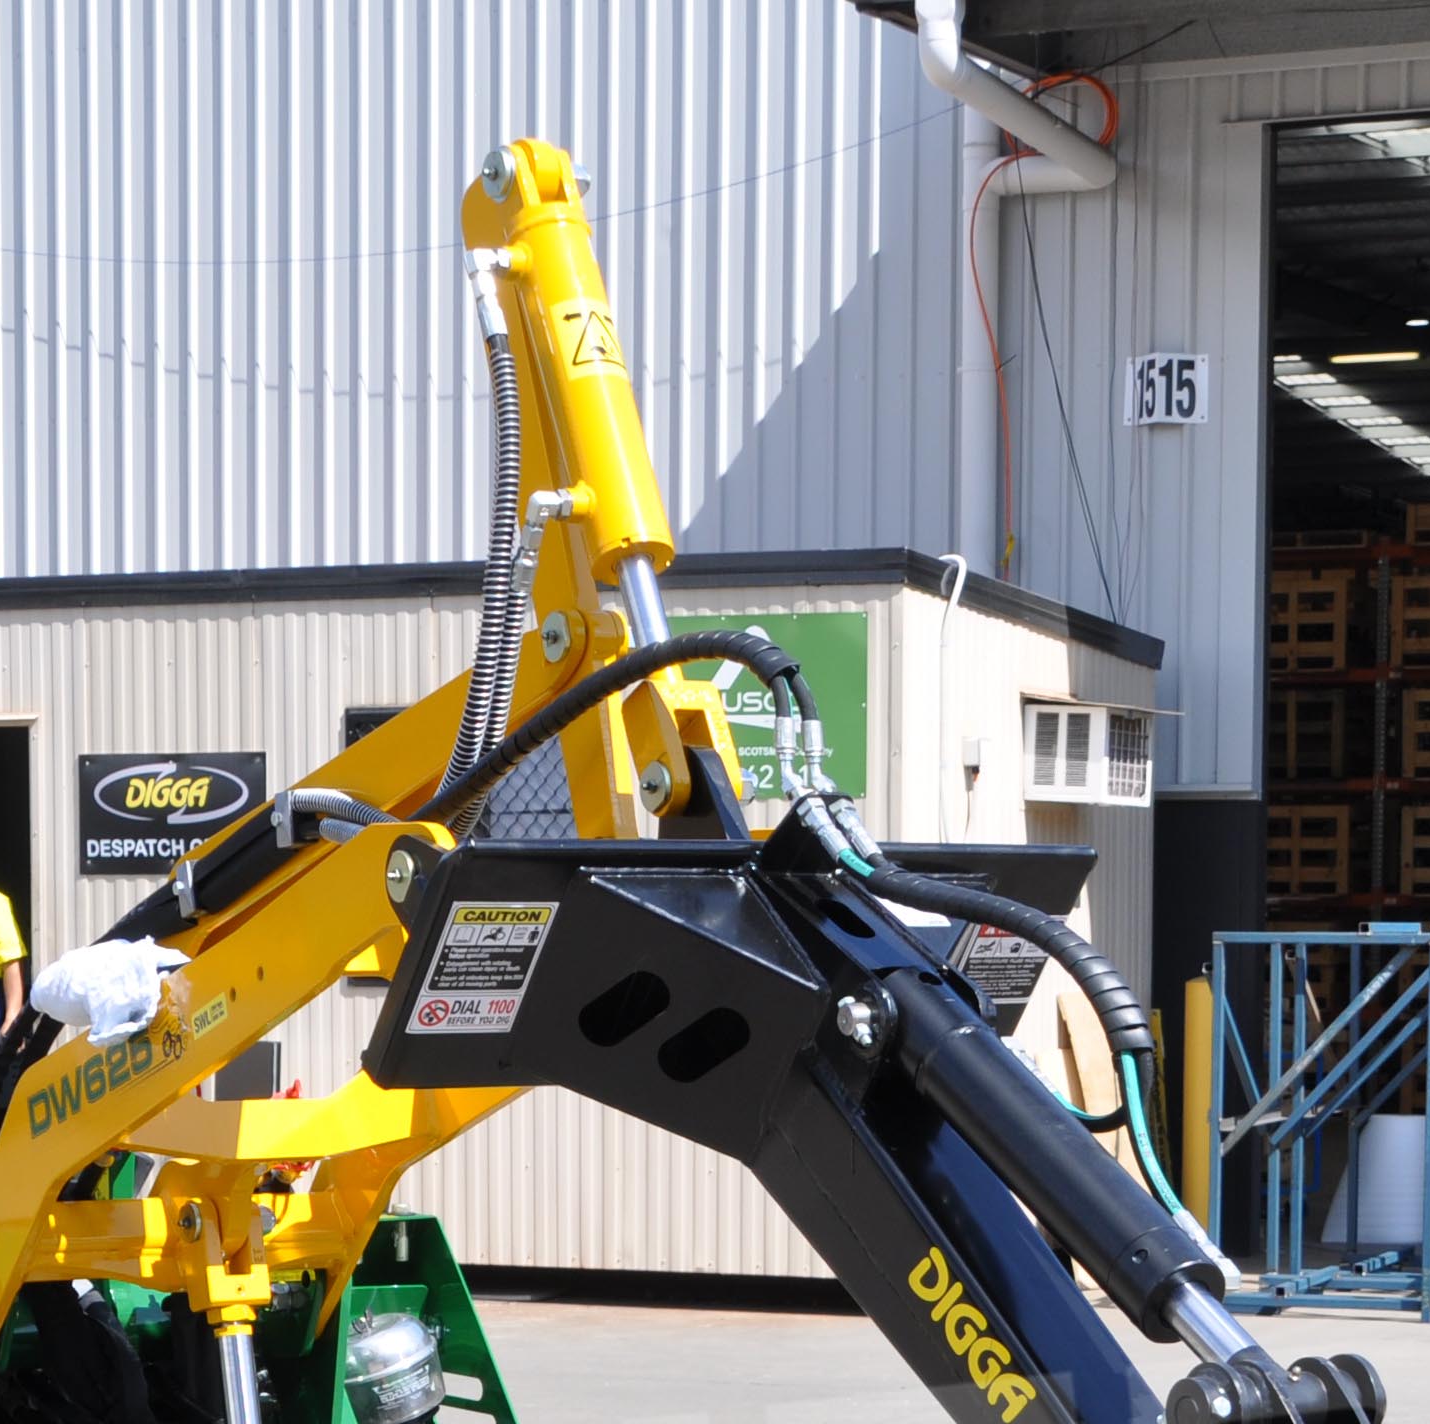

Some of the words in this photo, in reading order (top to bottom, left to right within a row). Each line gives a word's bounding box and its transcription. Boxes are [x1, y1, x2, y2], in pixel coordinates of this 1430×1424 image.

[1137, 358, 1156, 419] 15
[1158, 358, 1196, 418] 15
[125, 777, 210, 809] DIGGA
[86, 838, 184, 858] DESPATCH
[463, 911, 542, 922] CAUTION
[450, 1000, 481, 1015] DIAL
[486, 999, 516, 1014] 1100
[193, 1014, 212, 1034] SWL
[446, 1016, 476, 1025] BEFORE
[478, 1016, 493, 1024] YOU
[27, 1029, 153, 1139] DW625
[908, 1246, 1036, 1424] DIGGA
